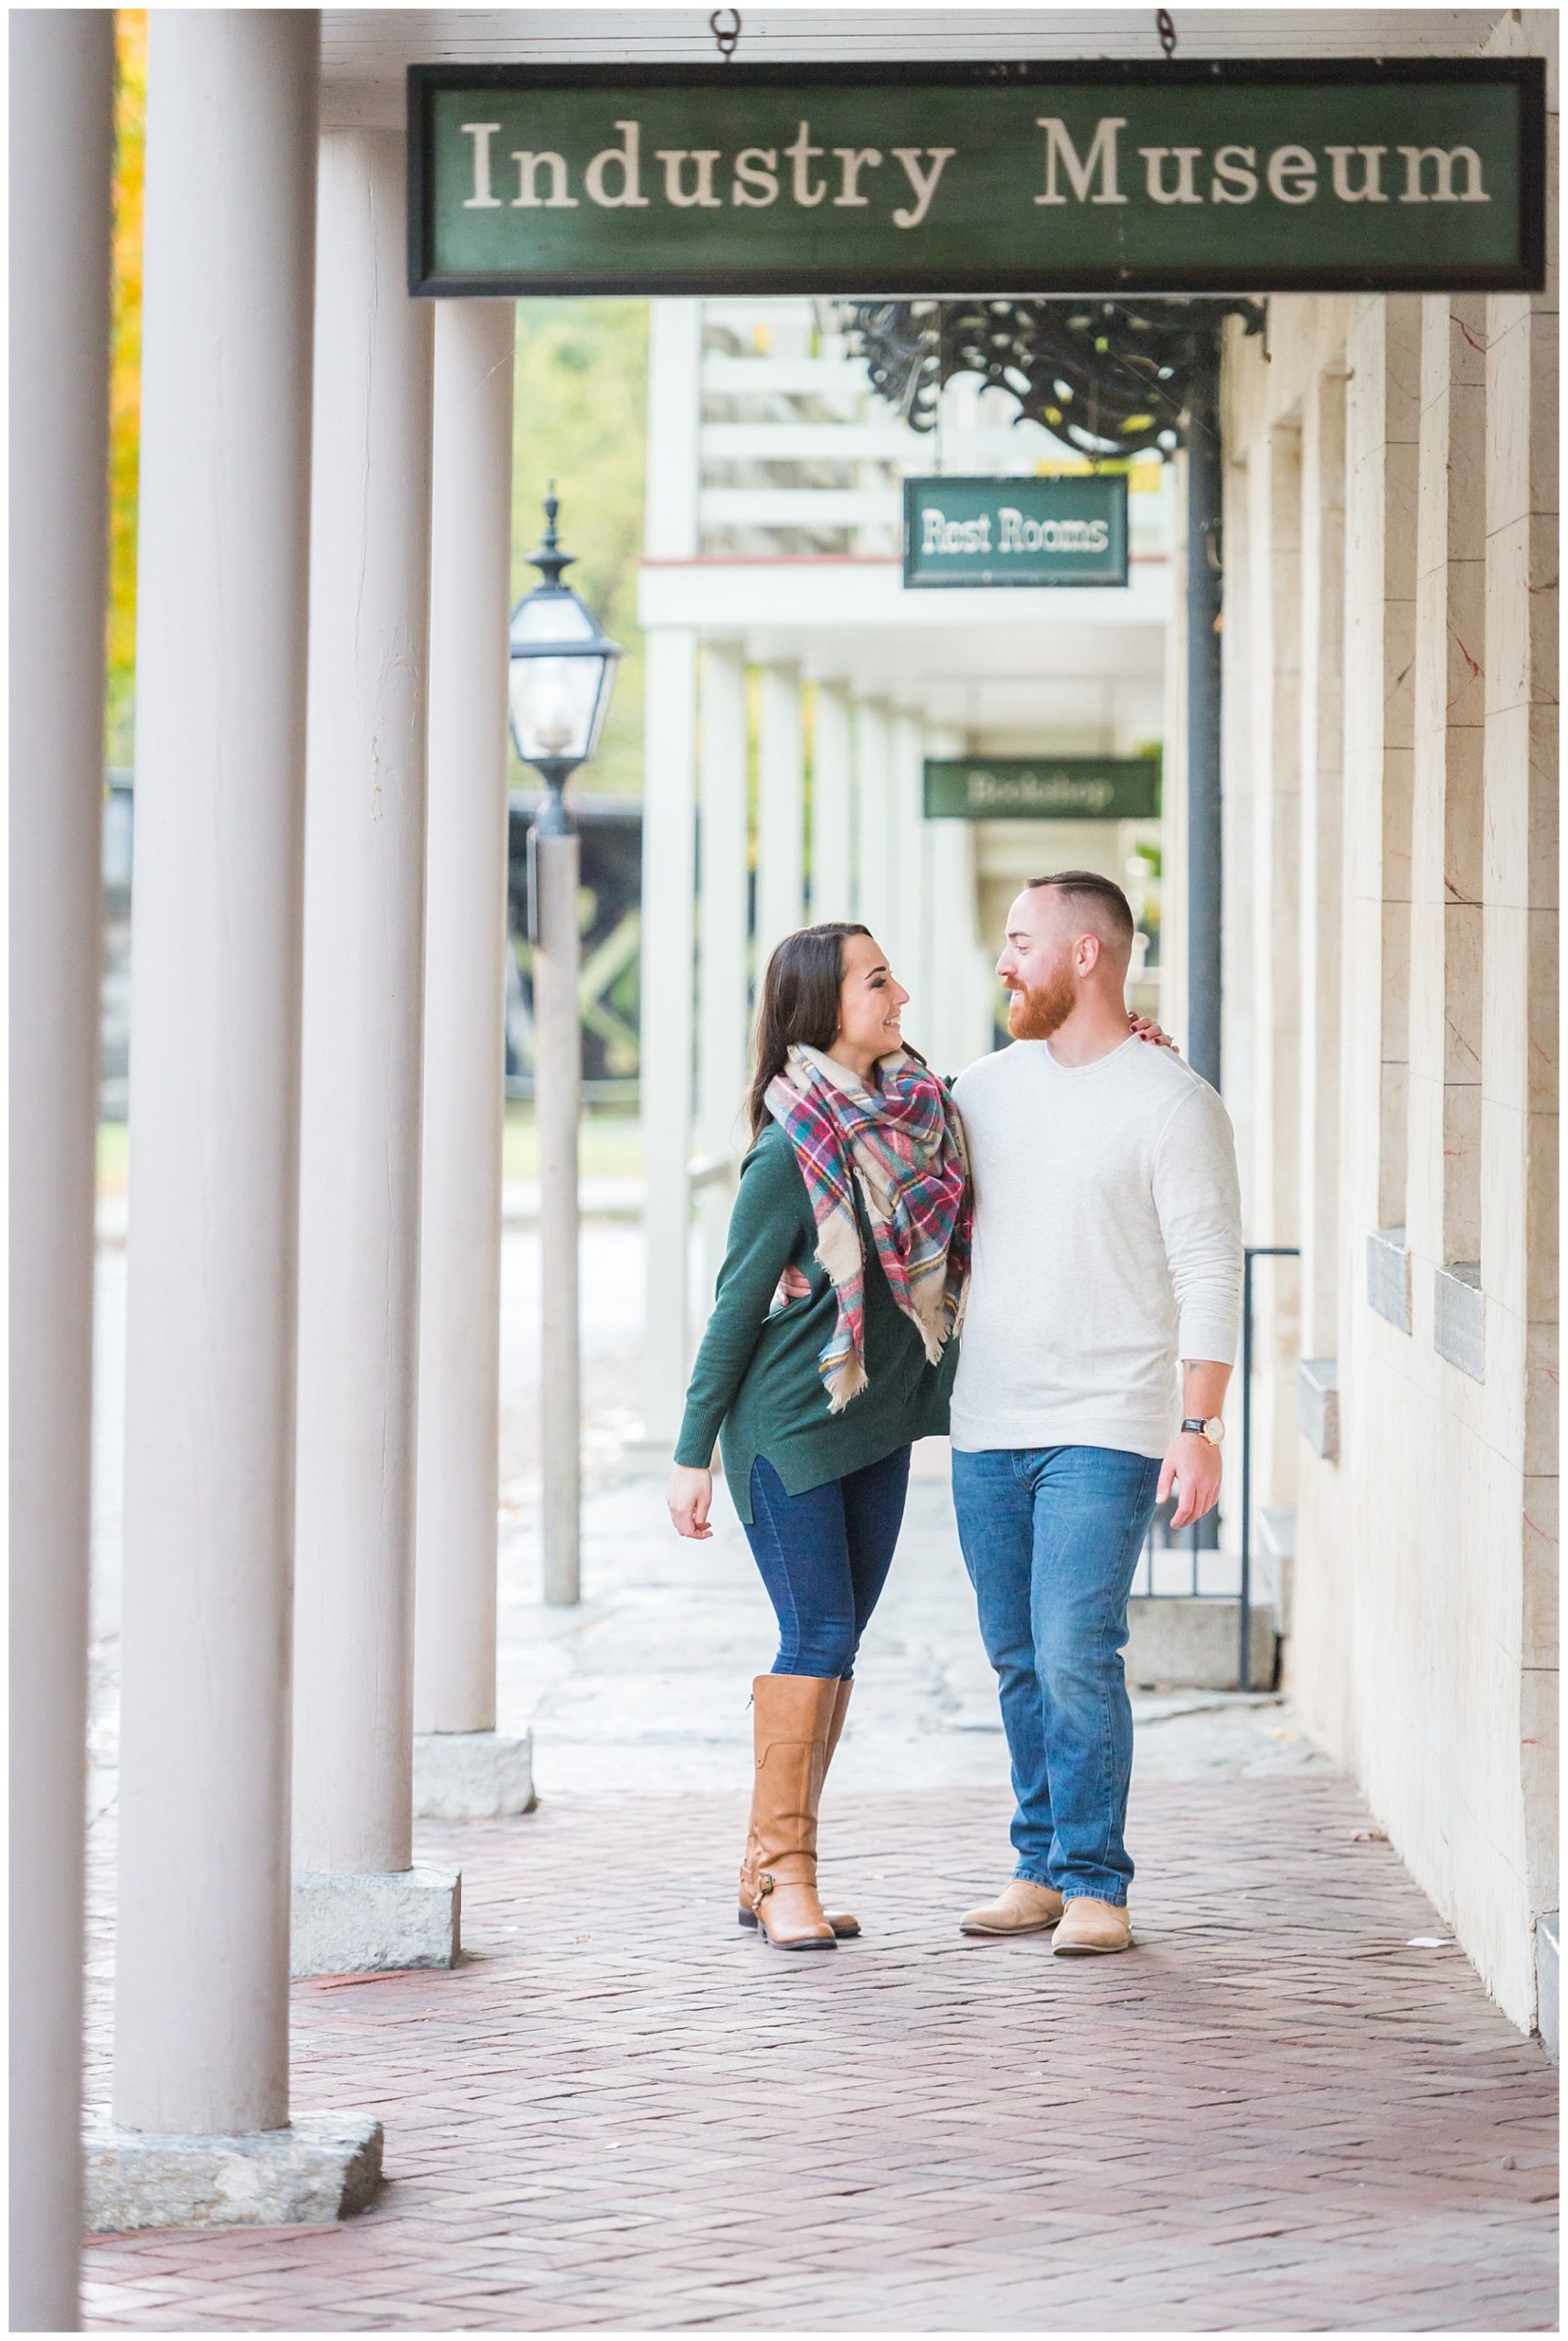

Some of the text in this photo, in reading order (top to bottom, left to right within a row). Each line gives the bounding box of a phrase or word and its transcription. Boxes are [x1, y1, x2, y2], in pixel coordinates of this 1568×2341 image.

[460, 117, 1491, 230] Industry Museum
[921, 507, 1110, 555] Rest Rooms
